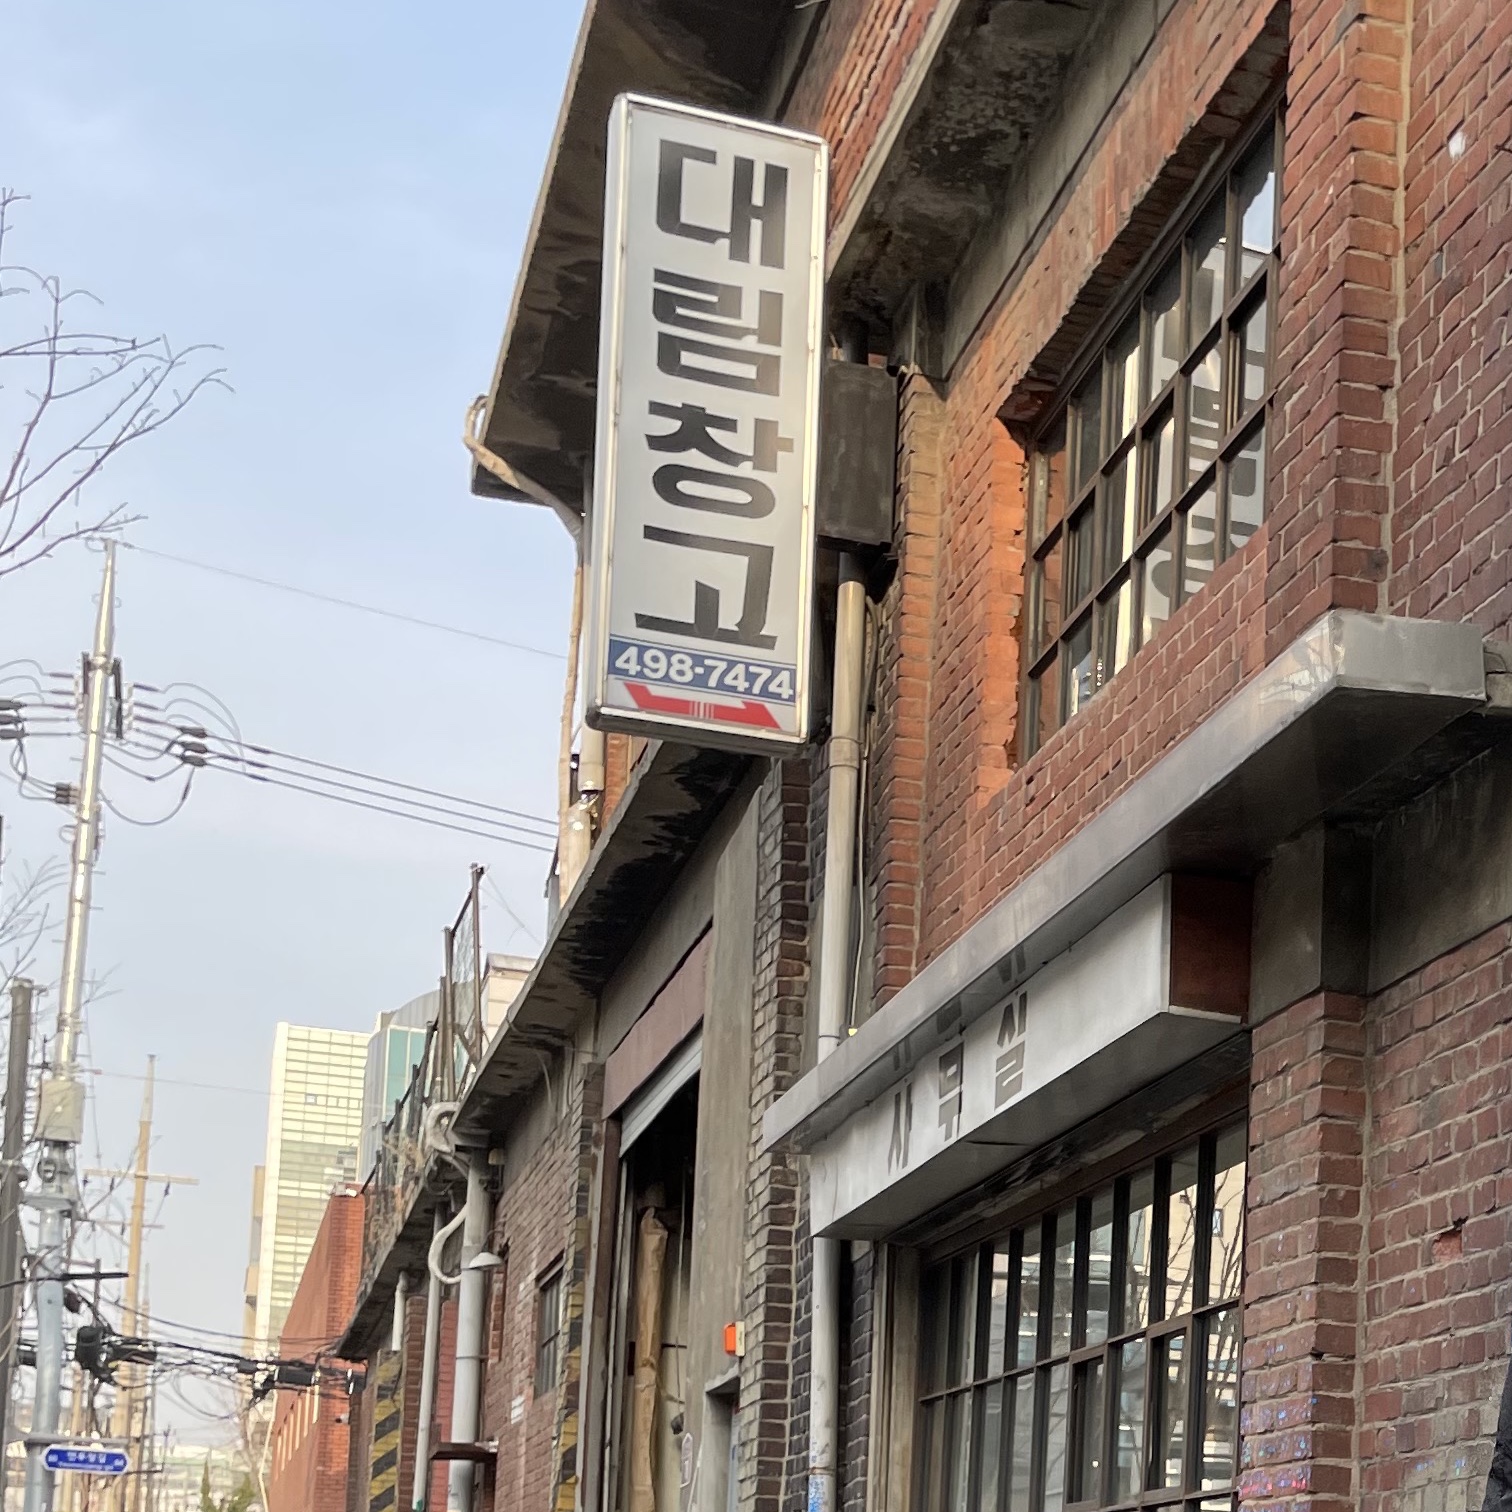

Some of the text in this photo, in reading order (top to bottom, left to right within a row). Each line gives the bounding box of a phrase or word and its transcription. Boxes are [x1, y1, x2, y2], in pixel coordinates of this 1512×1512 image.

[634, 139, 794, 651] 대림창고
[615, 646, 794, 699] 498-7474
[887, 990, 1028, 1177] 사무실
